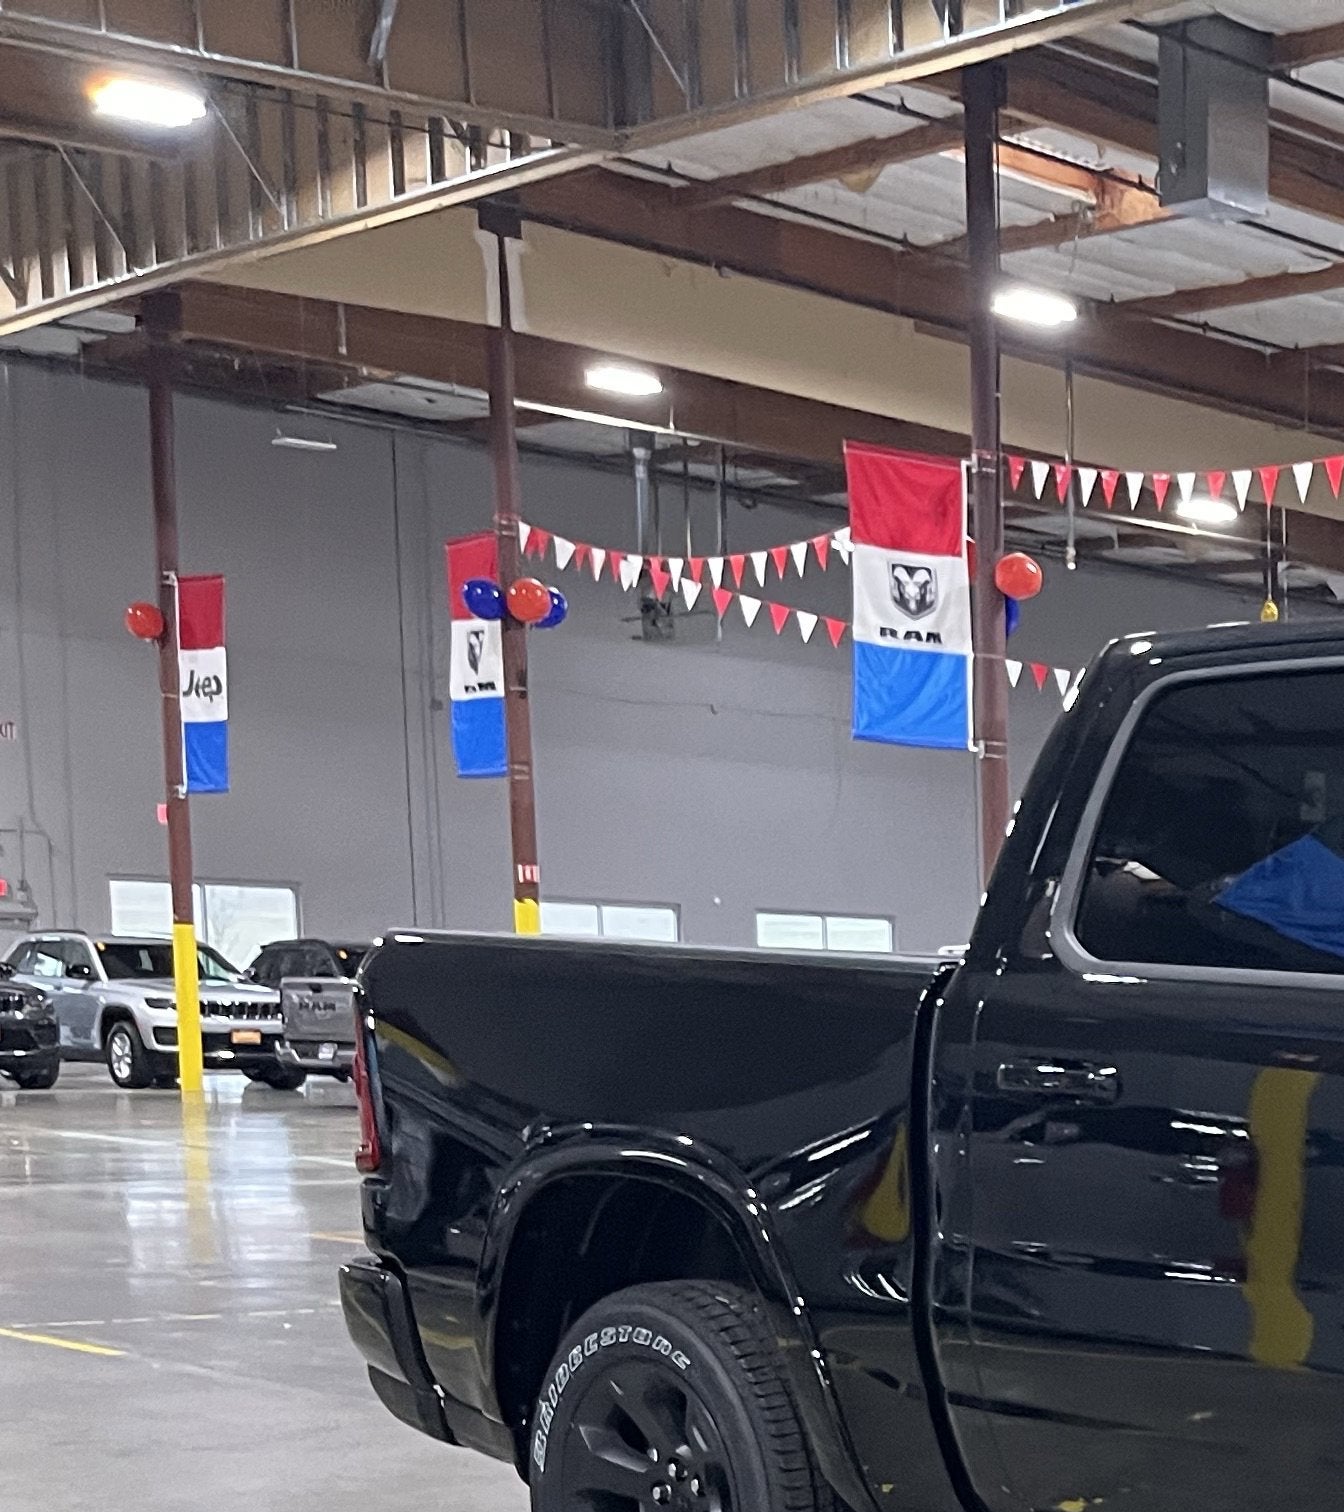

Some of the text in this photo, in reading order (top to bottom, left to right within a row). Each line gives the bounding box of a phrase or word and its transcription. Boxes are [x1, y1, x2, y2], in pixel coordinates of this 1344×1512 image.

[879, 626, 943, 645] RAM
[182, 669, 223, 704] Jeep
[533, 1324, 692, 1473] BRIDGESTONE
